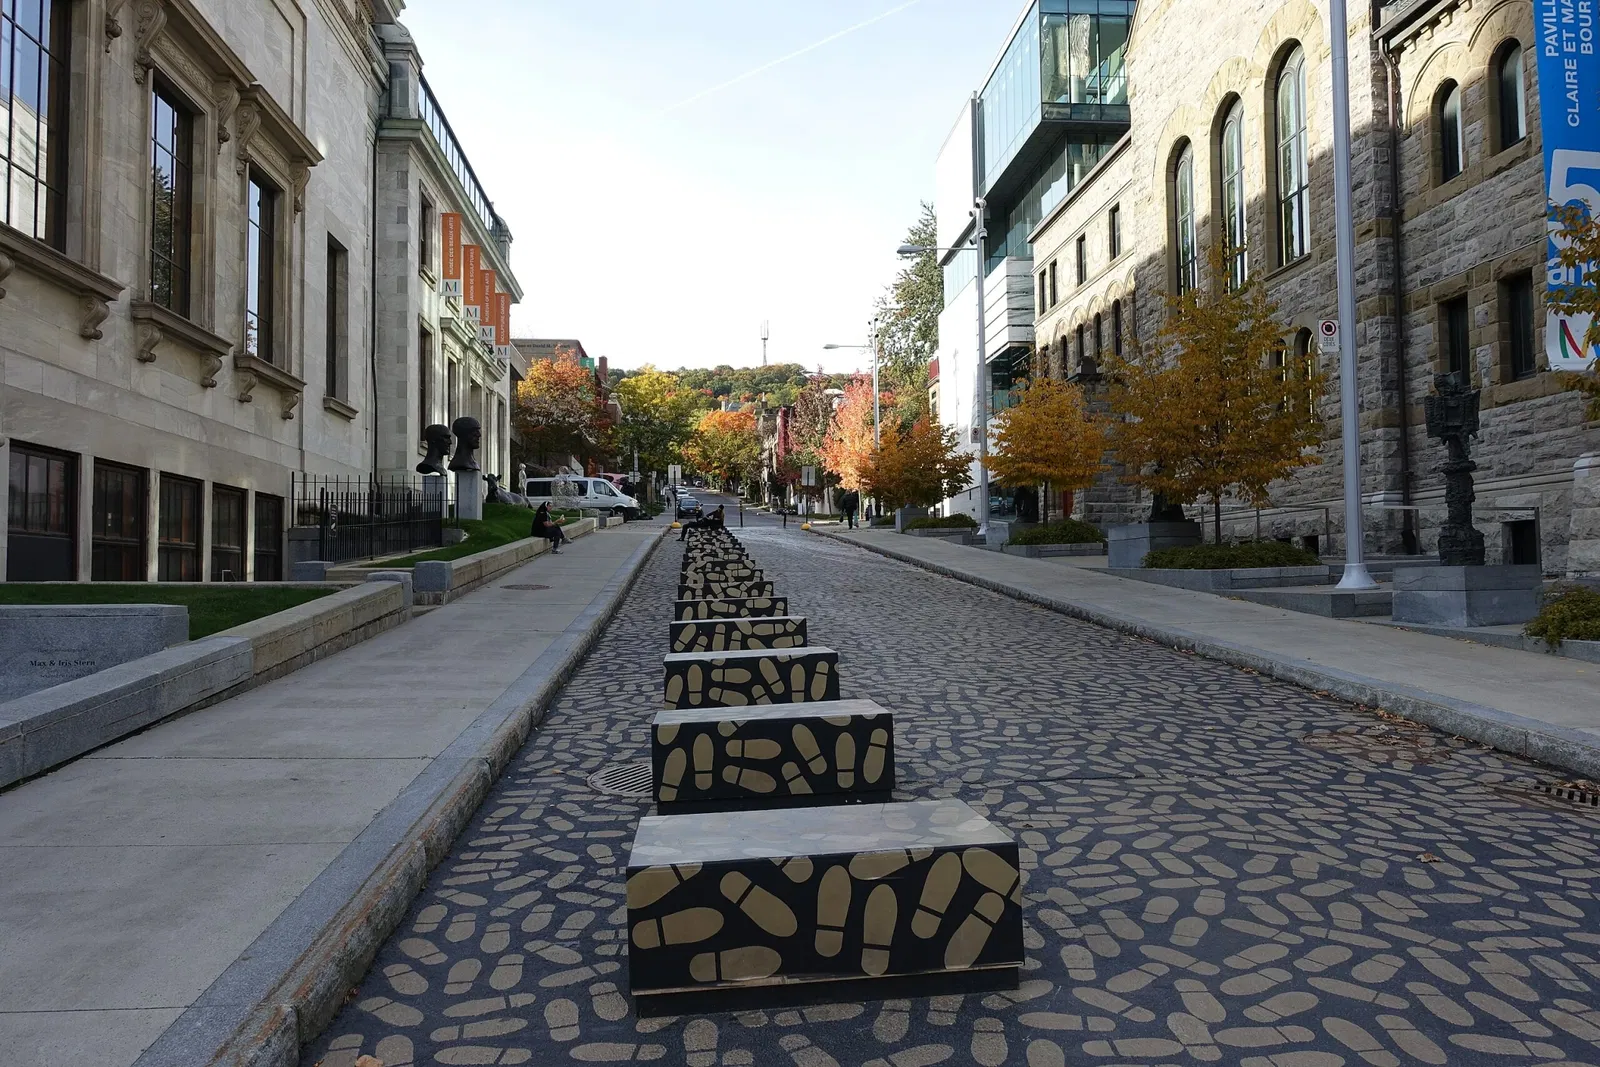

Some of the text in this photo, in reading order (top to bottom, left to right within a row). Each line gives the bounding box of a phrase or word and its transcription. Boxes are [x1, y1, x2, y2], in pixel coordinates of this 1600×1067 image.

[1578, 1, 1593, 55] BOUR
[1563, 29, 1576, 53] ET
[1565, 58, 1580, 127] CLAIRE
[446, 281, 456, 292] M
[466, 307, 477, 318] M
[482, 327, 492, 338] M
